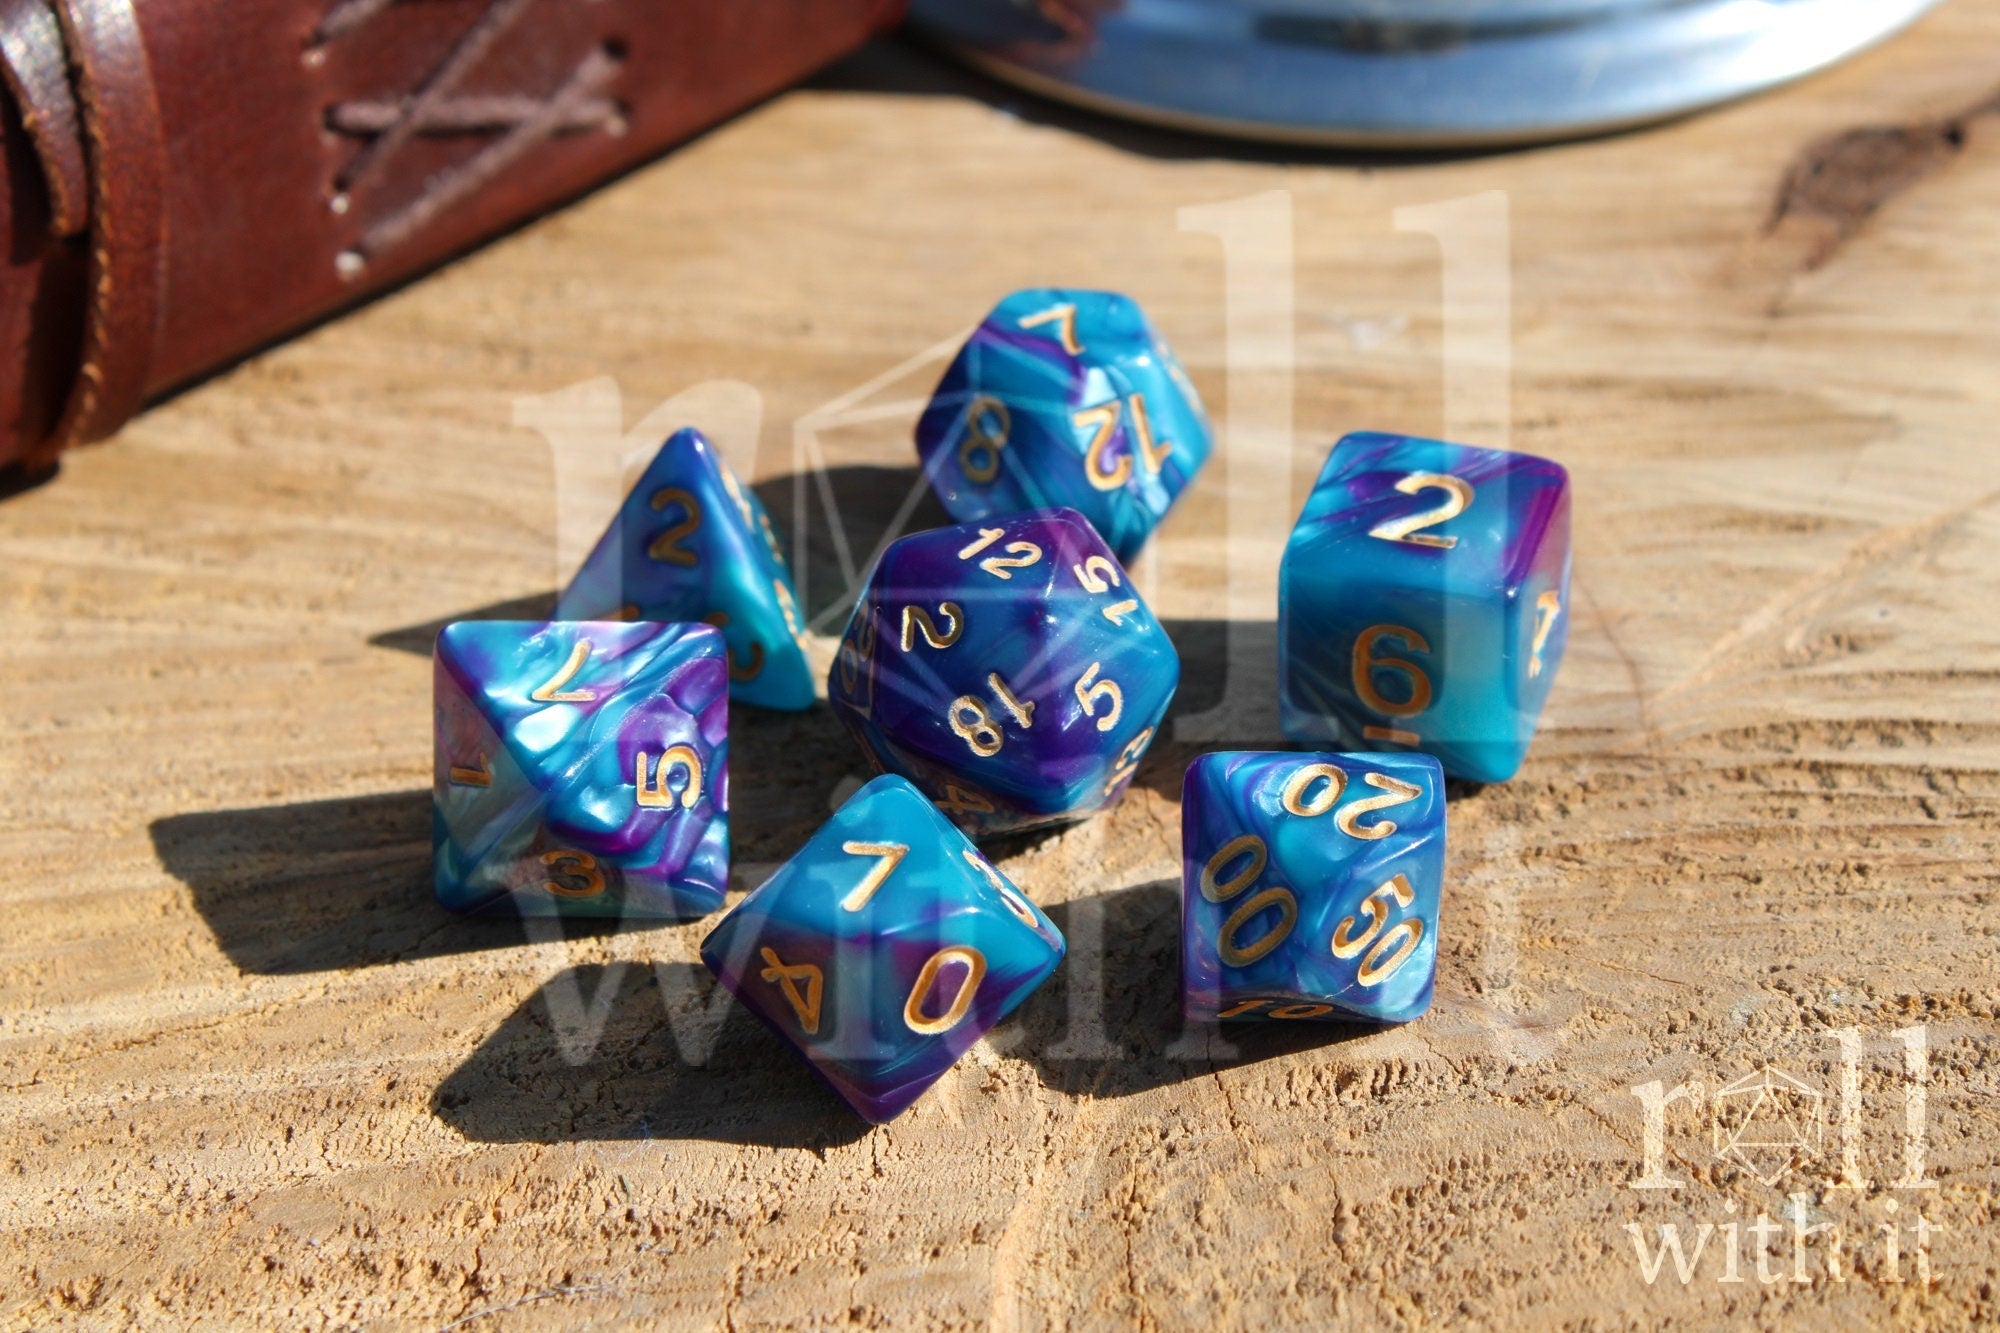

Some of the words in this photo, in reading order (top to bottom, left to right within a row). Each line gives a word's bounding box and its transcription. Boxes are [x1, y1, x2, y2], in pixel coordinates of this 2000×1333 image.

[1017, 303, 1084, 356] 7
[957, 395, 1012, 484] 8
[1072, 393, 1172, 491] 12
[648, 487, 700, 567] 2
[1367, 472, 1476, 550] 2
[957, 527, 1043, 580] 12
[1073, 555, 1139, 627] 15
[901, 602, 965, 652] 2
[531, 640, 597, 702] 7
[1074, 662, 1123, 732] 5
[1352, 624, 1432, 719] 6
[948, 672, 1036, 758] 18
[635, 744, 702, 808] 5
[1282, 763, 1424, 841] 20
[540, 849, 606, 898] 3
[841, 840, 911, 912] 7
[1200, 834, 1298, 968] 00
[1331, 873, 1425, 988] 50
[759, 946, 825, 1035] 4
[903, 945, 989, 1036] 0
